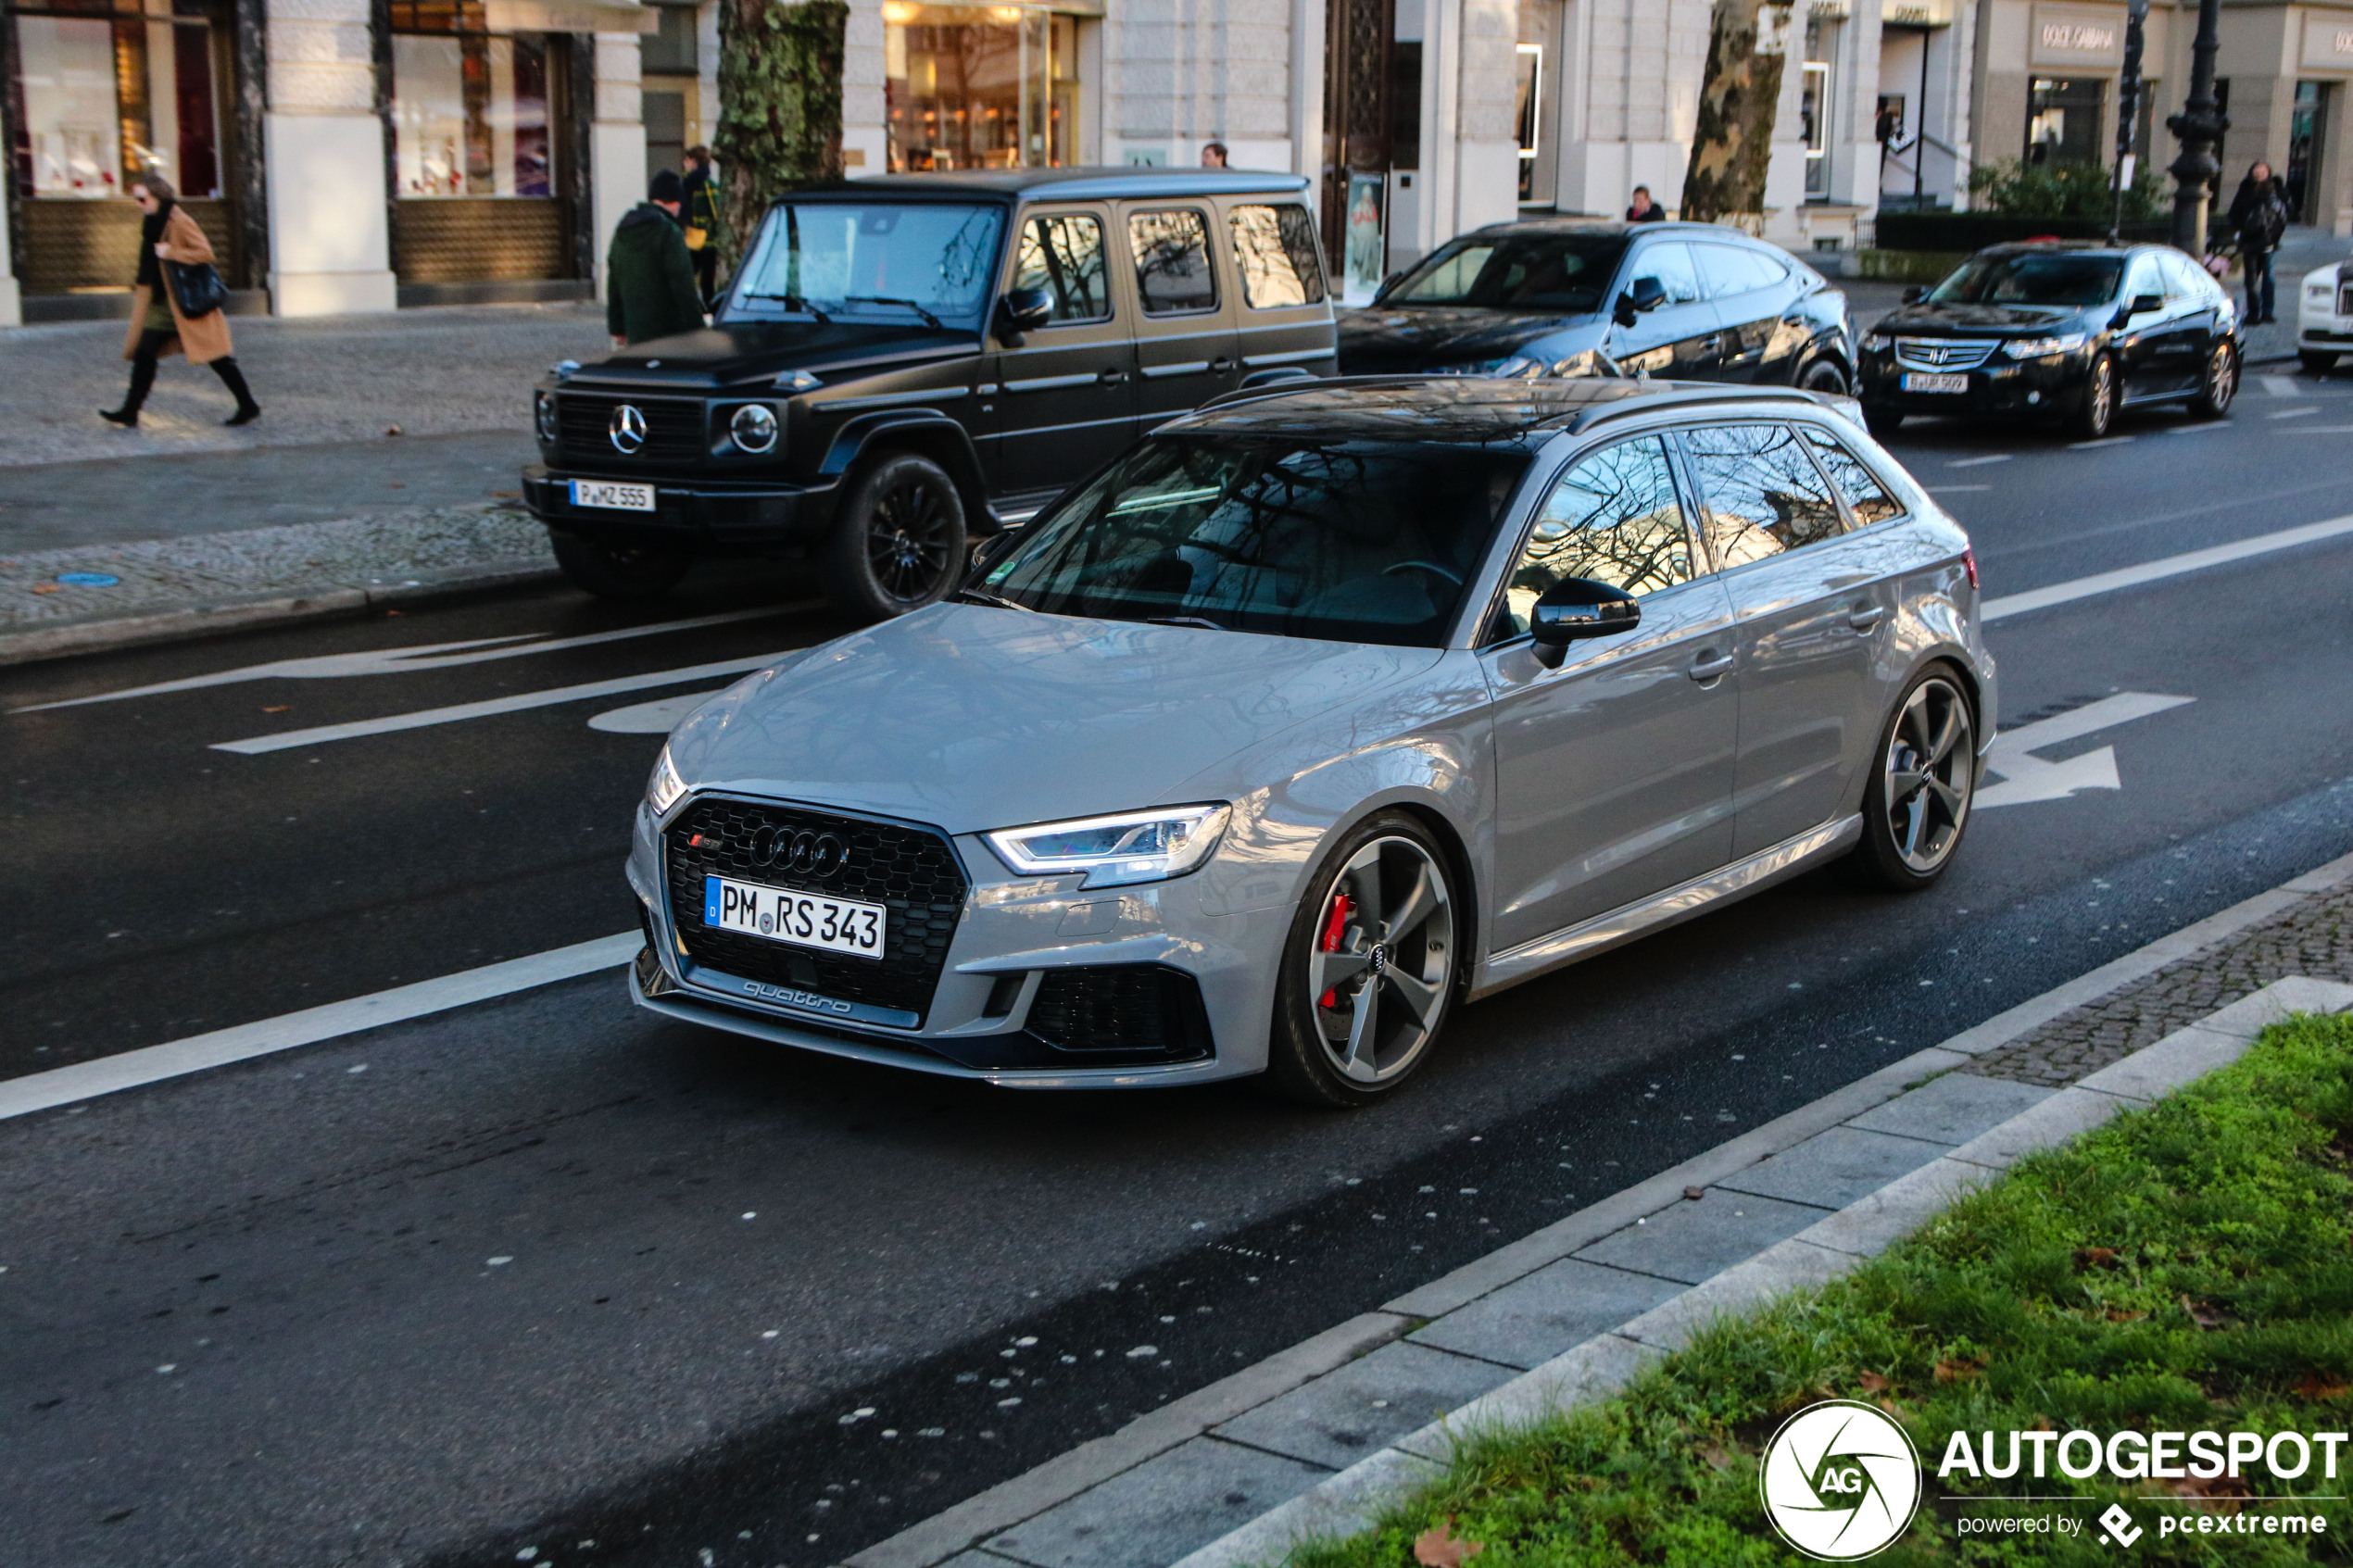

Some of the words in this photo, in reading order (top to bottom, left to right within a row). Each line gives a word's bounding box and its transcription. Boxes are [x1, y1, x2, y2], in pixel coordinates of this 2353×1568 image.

[619, 487, 647, 507] 555
[710, 906, 716, 918] D
[723, 884, 758, 927] PM
[776, 896, 814, 937] RS
[821, 903, 878, 948] 343
[743, 982, 851, 1013] quattro
